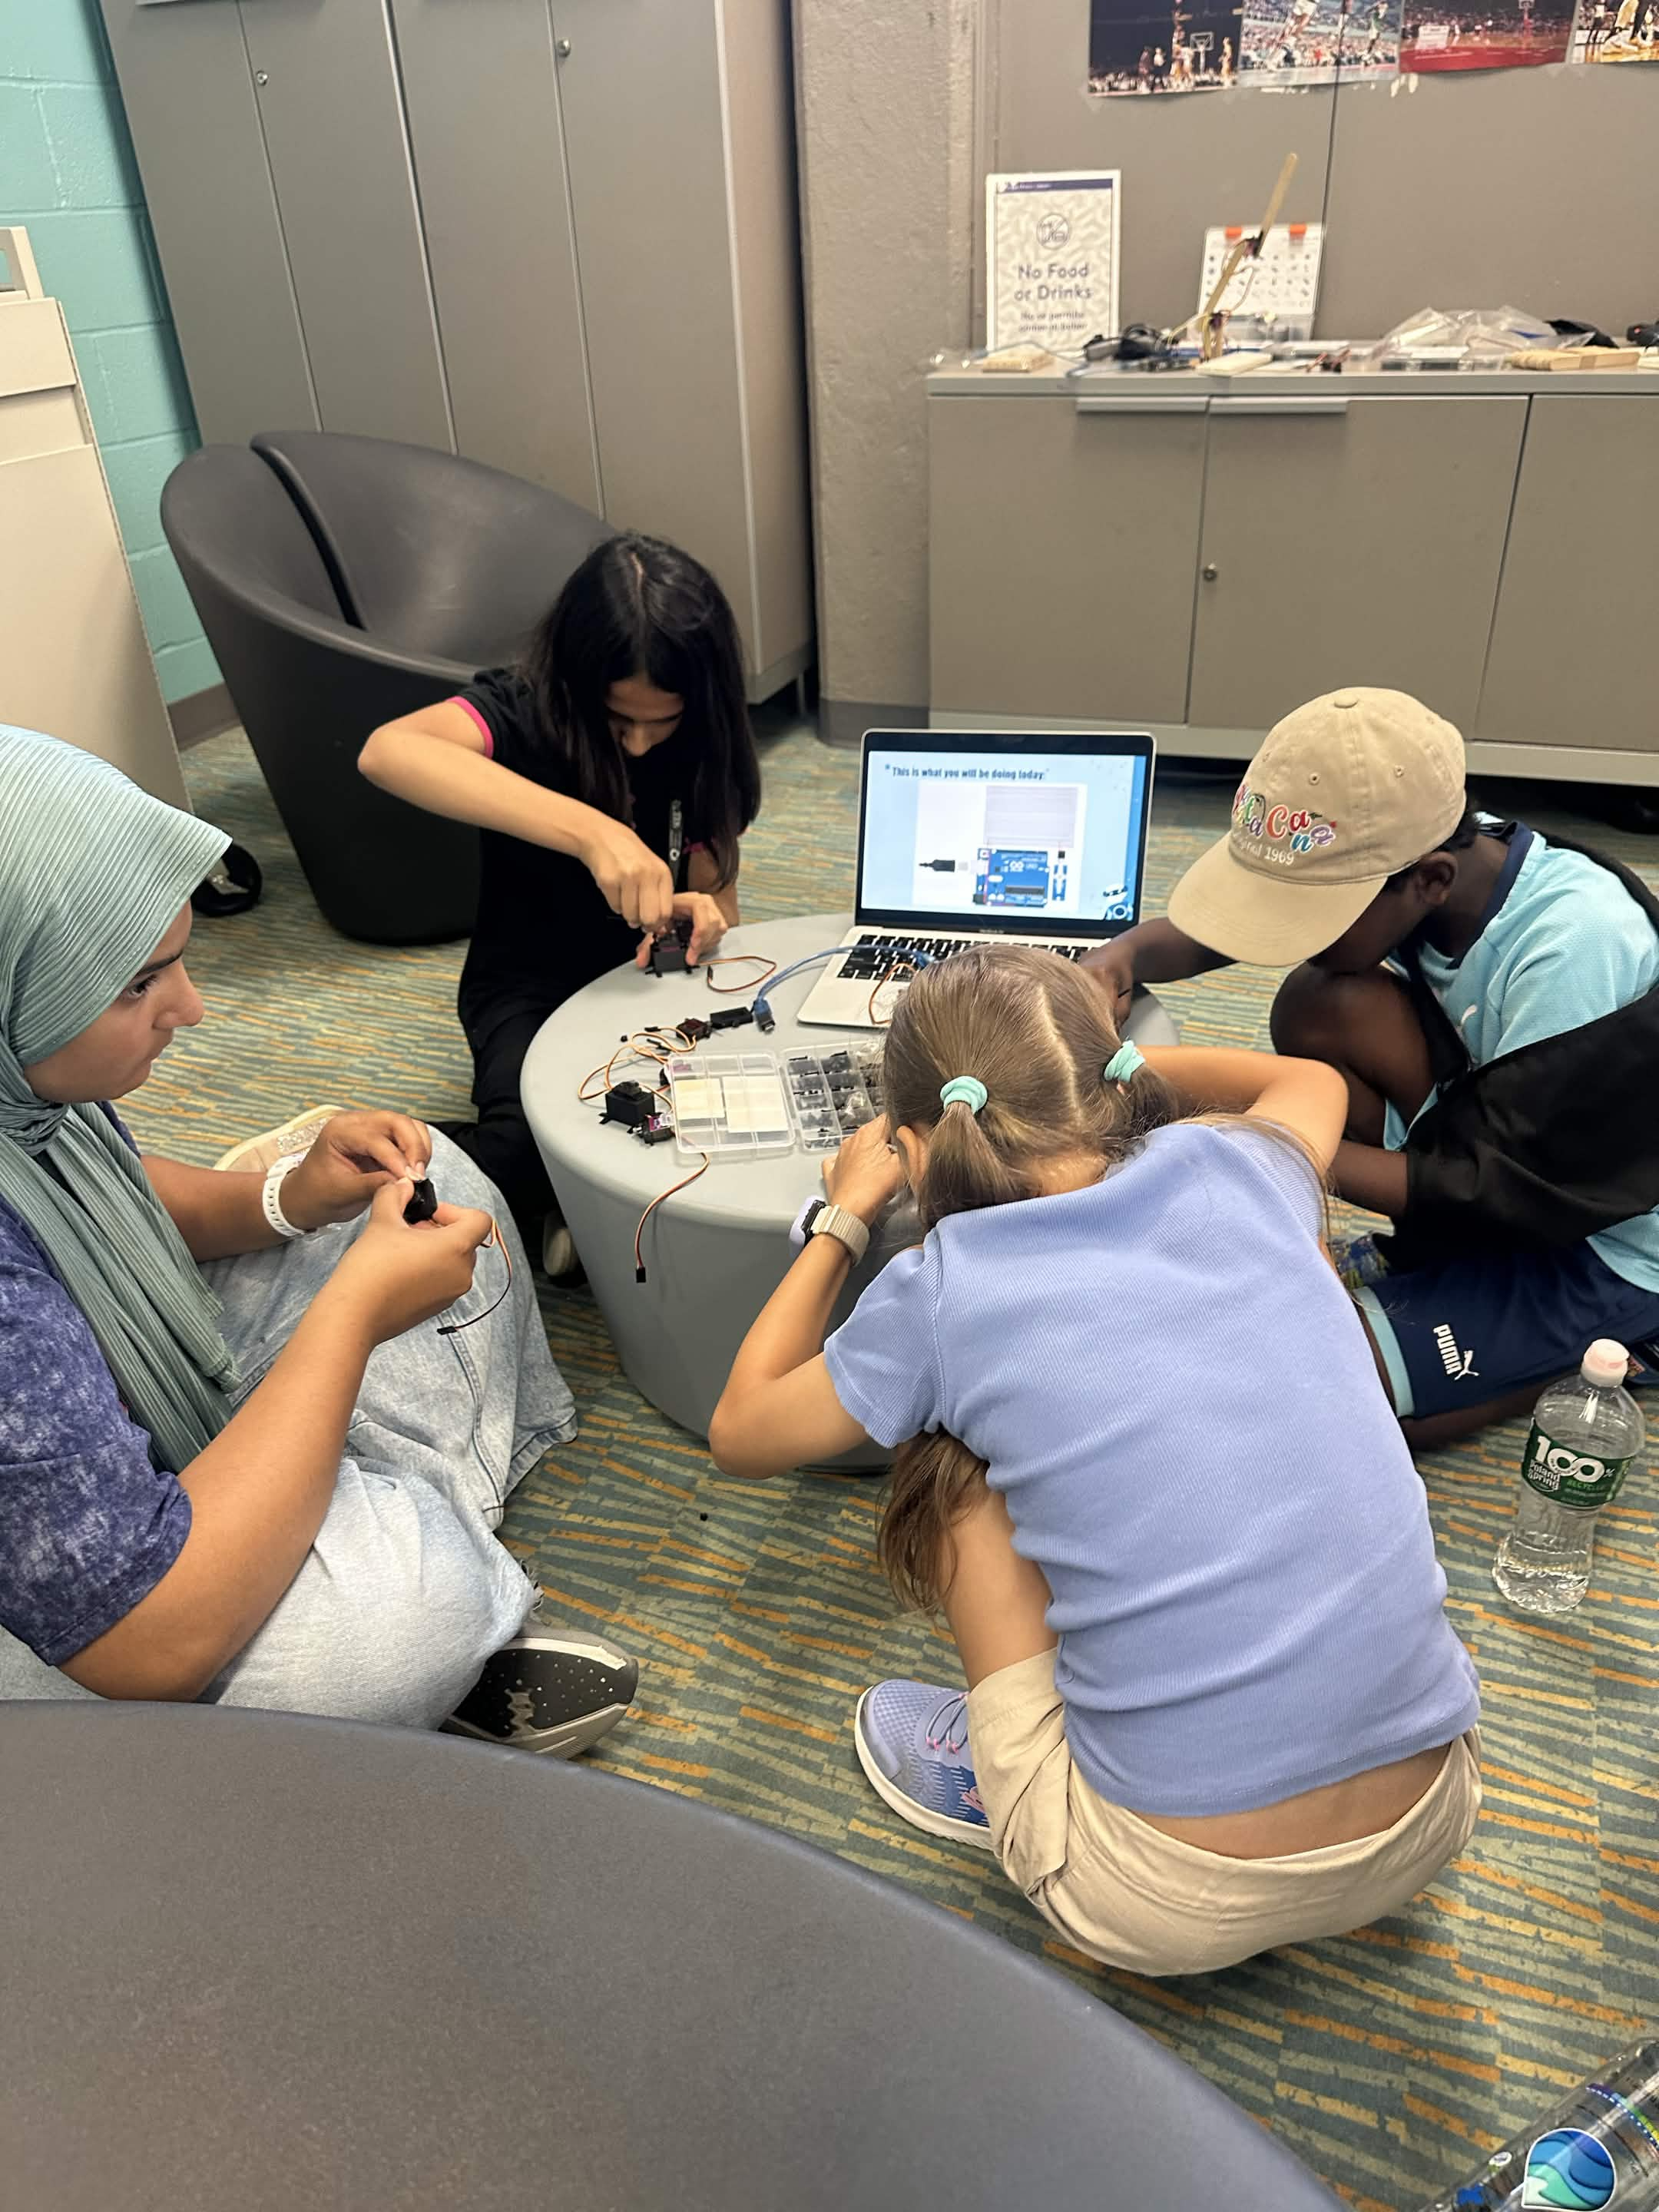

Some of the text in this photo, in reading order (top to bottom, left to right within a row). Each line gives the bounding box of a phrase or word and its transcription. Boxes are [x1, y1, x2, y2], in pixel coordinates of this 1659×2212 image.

[1018, 262, 1089, 280] No Food
[1014, 284, 1092, 301] or Drinks
[892, 767, 910, 777] This
[912, 767, 919, 777] is
[922, 767, 942, 778] what
[944, 770, 959, 780] you
[962, 769, 977, 778] will
[979, 769, 989, 779] be
[992, 769, 1016, 780] doing
[1265, 803, 1336, 853] Cana
[1263, 846, 1294, 866] 1969
[1433, 1324, 1463, 1376] PUMA
[1528, 1468, 1560, 1491] Spring
[1529, 1459, 1561, 1483] Poland
